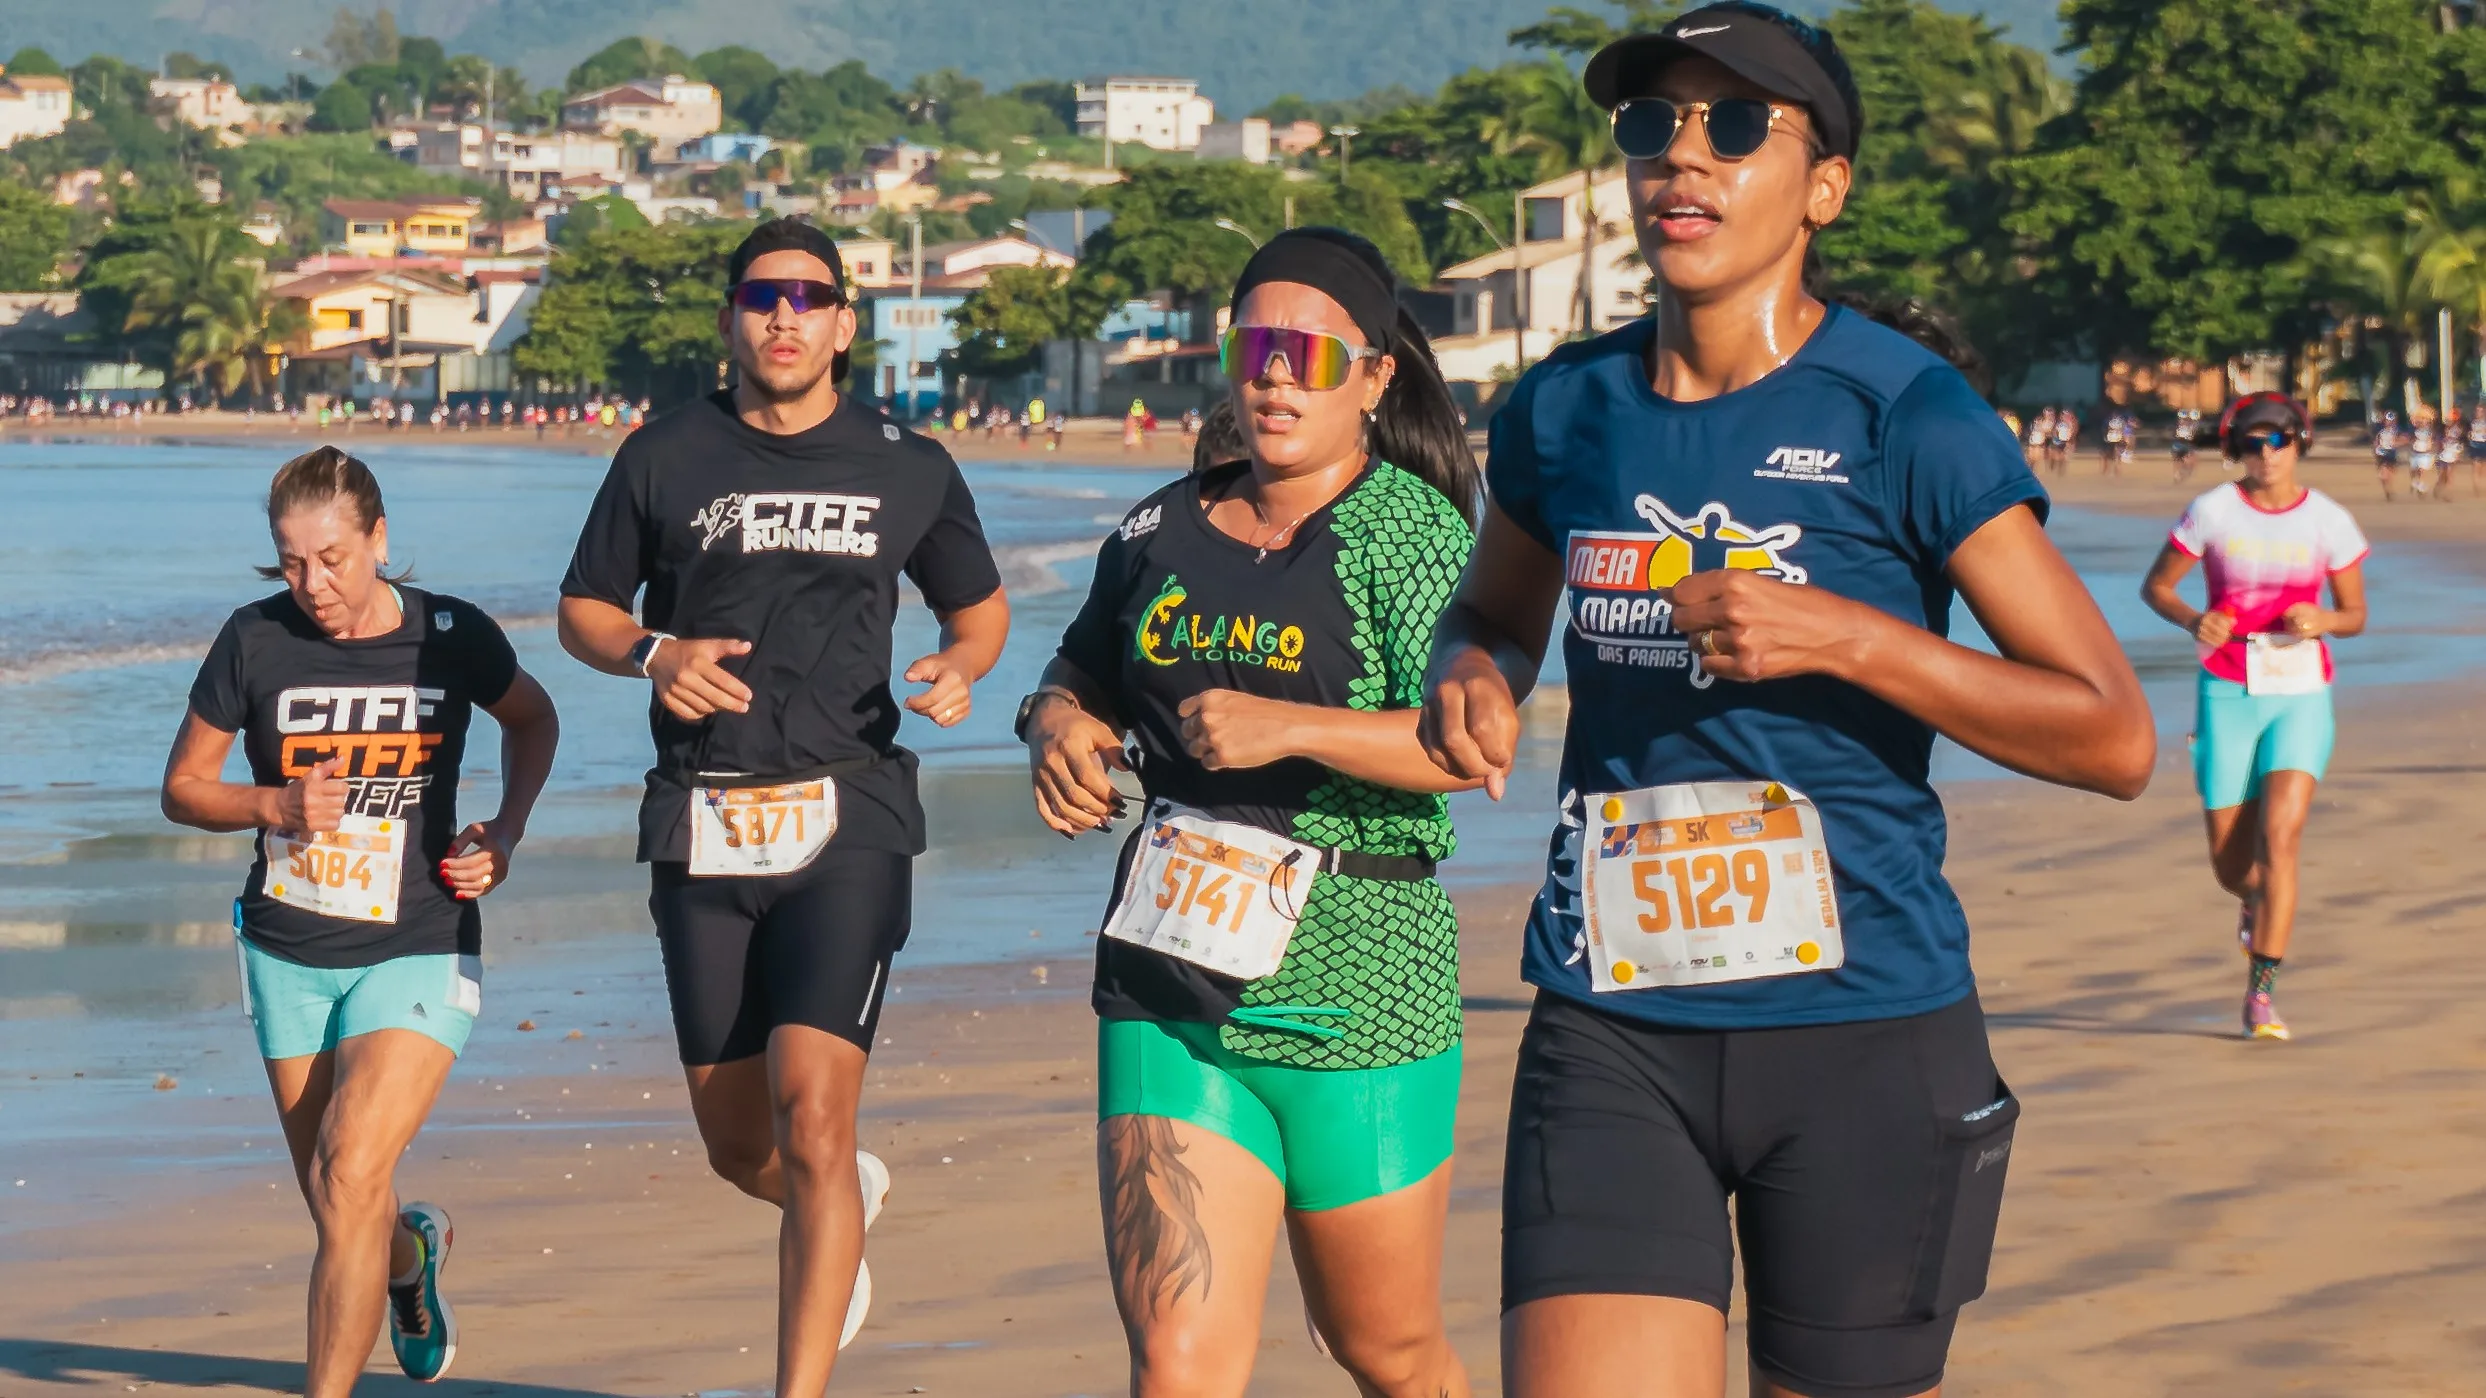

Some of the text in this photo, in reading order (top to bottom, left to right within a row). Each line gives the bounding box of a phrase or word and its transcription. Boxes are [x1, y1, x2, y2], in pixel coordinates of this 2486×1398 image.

[742, 493, 880, 532] CTFF
[743, 527, 878, 557] RUNNERS
[1570, 545, 1640, 585] MEIA
[1580, 596, 1682, 634] MARA
[1266, 656, 1302, 672] RUN
[1597, 644, 1690, 668] DAS PRAIAS
[277, 686, 445, 734] CTFF
[281, 732, 444, 777] CTFF
[722, 805, 805, 848] 5871
[1685, 820, 1710, 843] 5K
[287, 845, 372, 891] 5084
[1155, 856, 1257, 935] 5141
[1632, 848, 1771, 934] 5129
